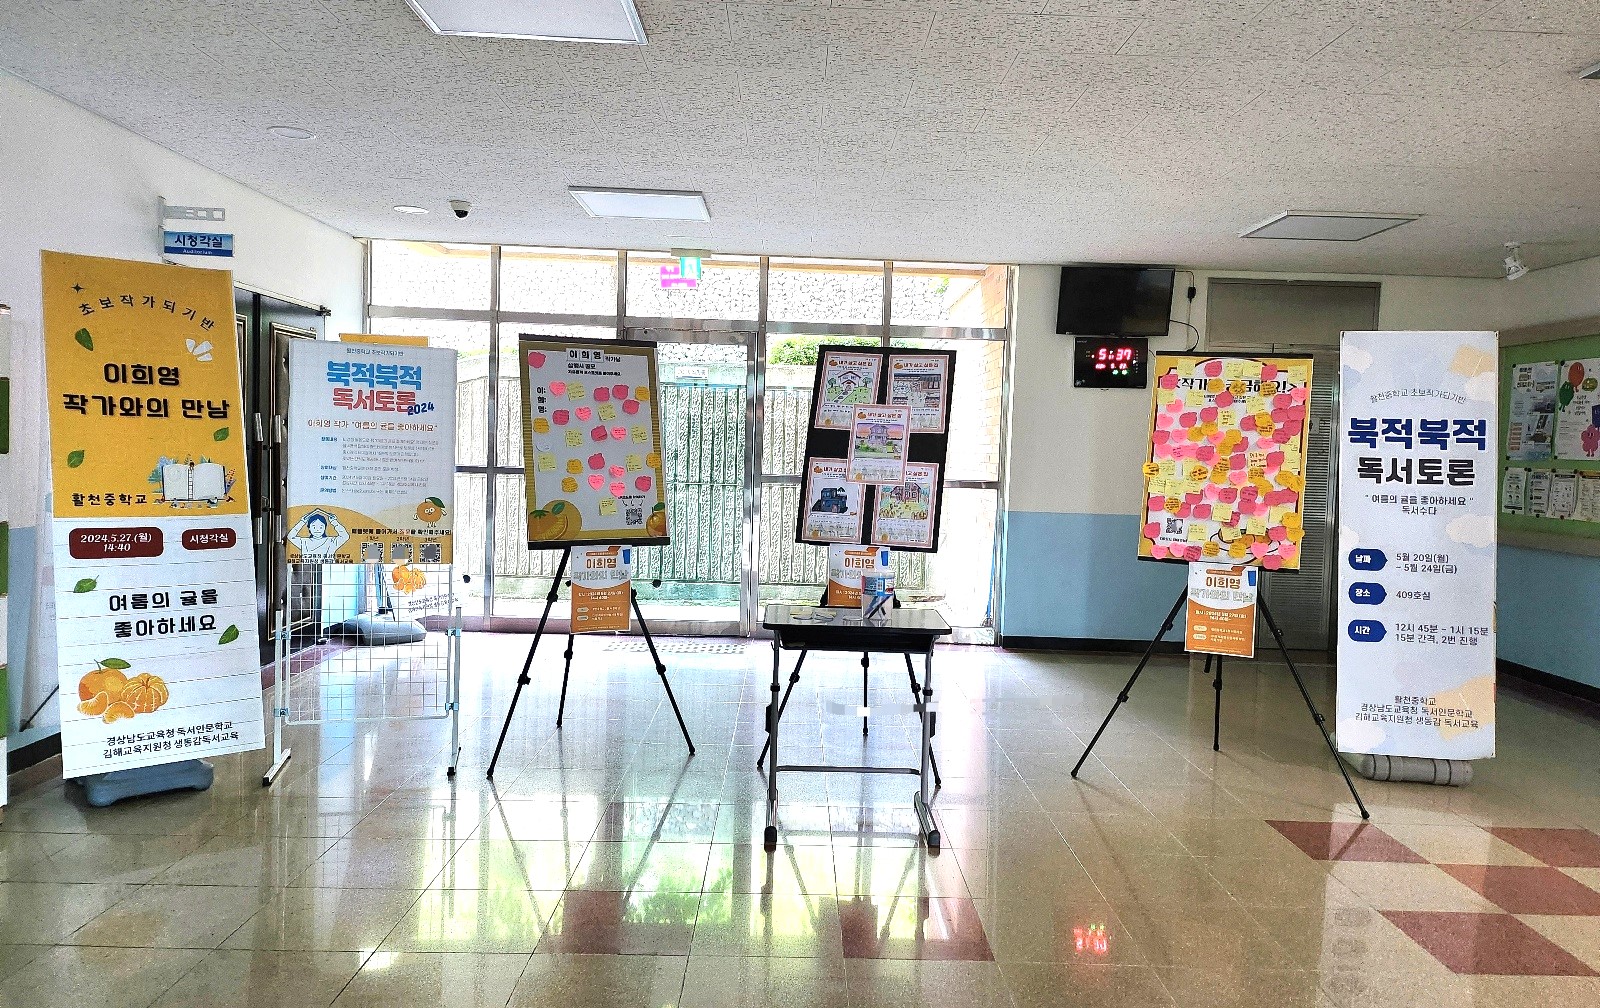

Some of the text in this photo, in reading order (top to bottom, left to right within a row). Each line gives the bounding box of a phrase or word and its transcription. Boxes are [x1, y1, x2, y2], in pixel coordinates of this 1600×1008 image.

[174, 234, 223, 248] 시청각실
[78, 293, 215, 332] 초보작가되기반
[103, 361, 180, 386] 이희영
[326, 360, 422, 390] 북적북적
[62, 393, 230, 420] 작가와의 만남
[332, 387, 435, 416] 독서토론 2024
[333, 420, 349, 428] 작가
[1347, 417, 1487, 451] 북적북적
[1357, 456, 1476, 486] 독서토론
[71, 492, 148, 506] 활천중학교
[1401, 506, 1437, 515] 독서수다
[80, 532, 153, 544] 2024.5.27.(월)
[189, 533, 229, 544] 시청각실
[102, 543, 131, 552] 14:40
[586, 557, 617, 569] 이희영
[844, 557, 875, 569] 이희영
[1355, 554, 1372, 564] 날짜
[1396, 553, 1449, 564] 5월 20일(월)
[1404, 564, 1418, 573] 5월
[1421, 564, 1458, 575] 24일(금)
[1205, 575, 1241, 590] 이희영
[1355, 587, 1371, 598] 장소
[1395, 589, 1431, 600] 409호실
[109, 588, 219, 612] 여름의 귤을
[113, 614, 217, 638] 좋아하세요
[1354, 625, 1370, 635] 시간
[1396, 623, 1415, 633] 12시
[1417, 624, 1439, 634] 45분
[1449, 625, 1465, 635] 1시
[1468, 626, 1489, 636] 15분
[1396, 633, 1479, 646] 15분 간격, 2번 진행
[1360, 703, 1473, 719] 경상남도교육청 독서인문학교
[1415, 716, 1442, 727] 생동감
[1444, 718, 1479, 729] 독서교육
[106, 720, 233, 747] 경상남도교육청 독서인문학교
[103, 740, 172, 759] 김해교육지원청
